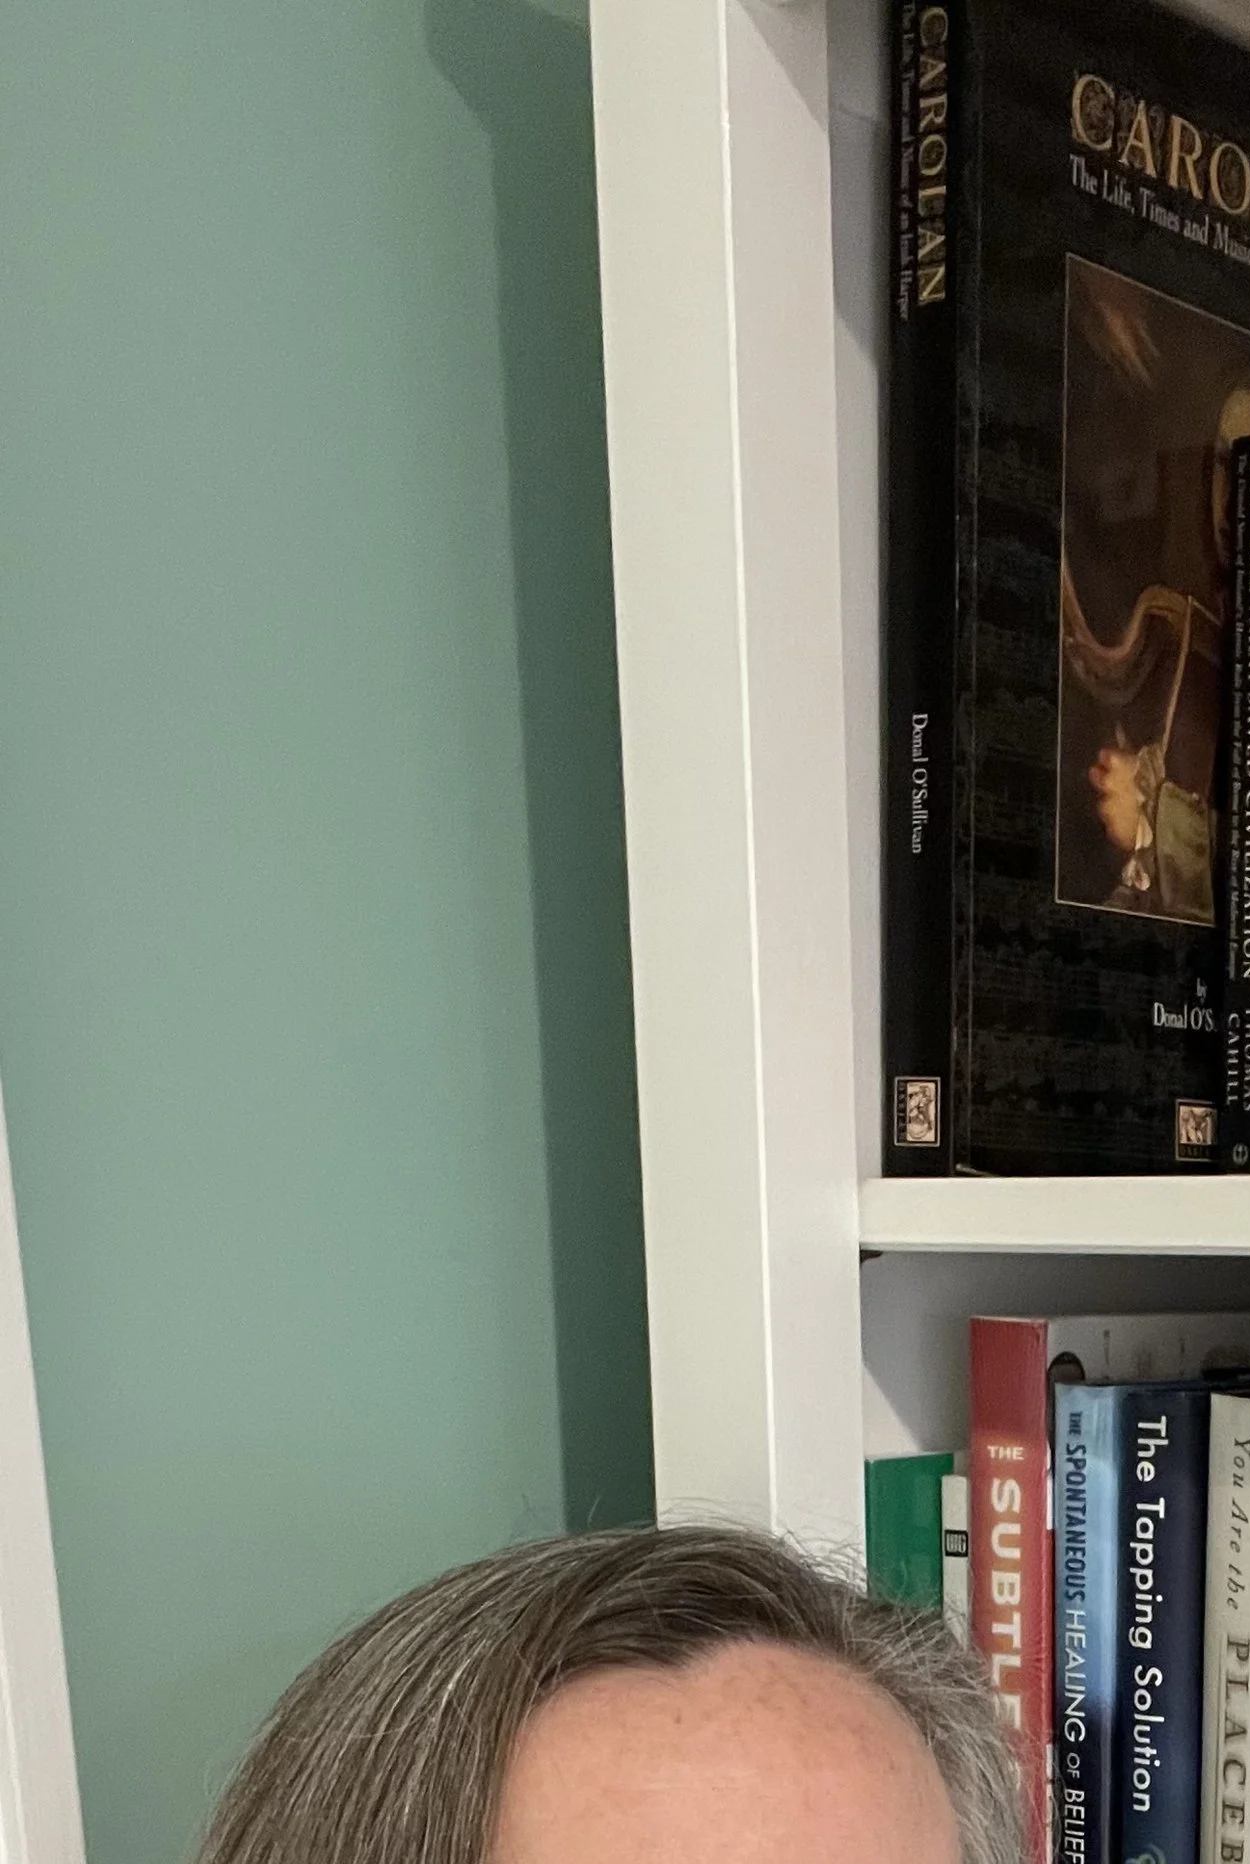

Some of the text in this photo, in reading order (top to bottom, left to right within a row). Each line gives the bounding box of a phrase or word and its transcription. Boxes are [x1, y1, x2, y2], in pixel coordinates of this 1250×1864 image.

[919, 7, 948, 304] CAROLAN
[1069, 153, 1098, 196] The
[1102, 168, 1135, 216] Life,
[1139, 186, 1181, 233] Times
[1184, 214, 1210, 246] and
[911, 712, 929, 854] Donal O'Sullivan
[1153, 1002, 1188, 1029] Donal
[1226, 1012, 1241, 1106] CAHILL
[987, 1444, 1025, 1461] THE
[1068, 1411, 1082, 1437] THE
[1064, 1443, 1087, 1603] SPONTANEOUS
[1229, 1497, 1249, 1554] Are
[990, 1478, 1022, 1730] SUBTLE
[1128, 1415, 1169, 1812] The Tapping Solution
[1226, 1563, 1246, 1611] the
[1063, 1608, 1086, 1743] HEALING
[1066, 1752, 1081, 1778] OF
